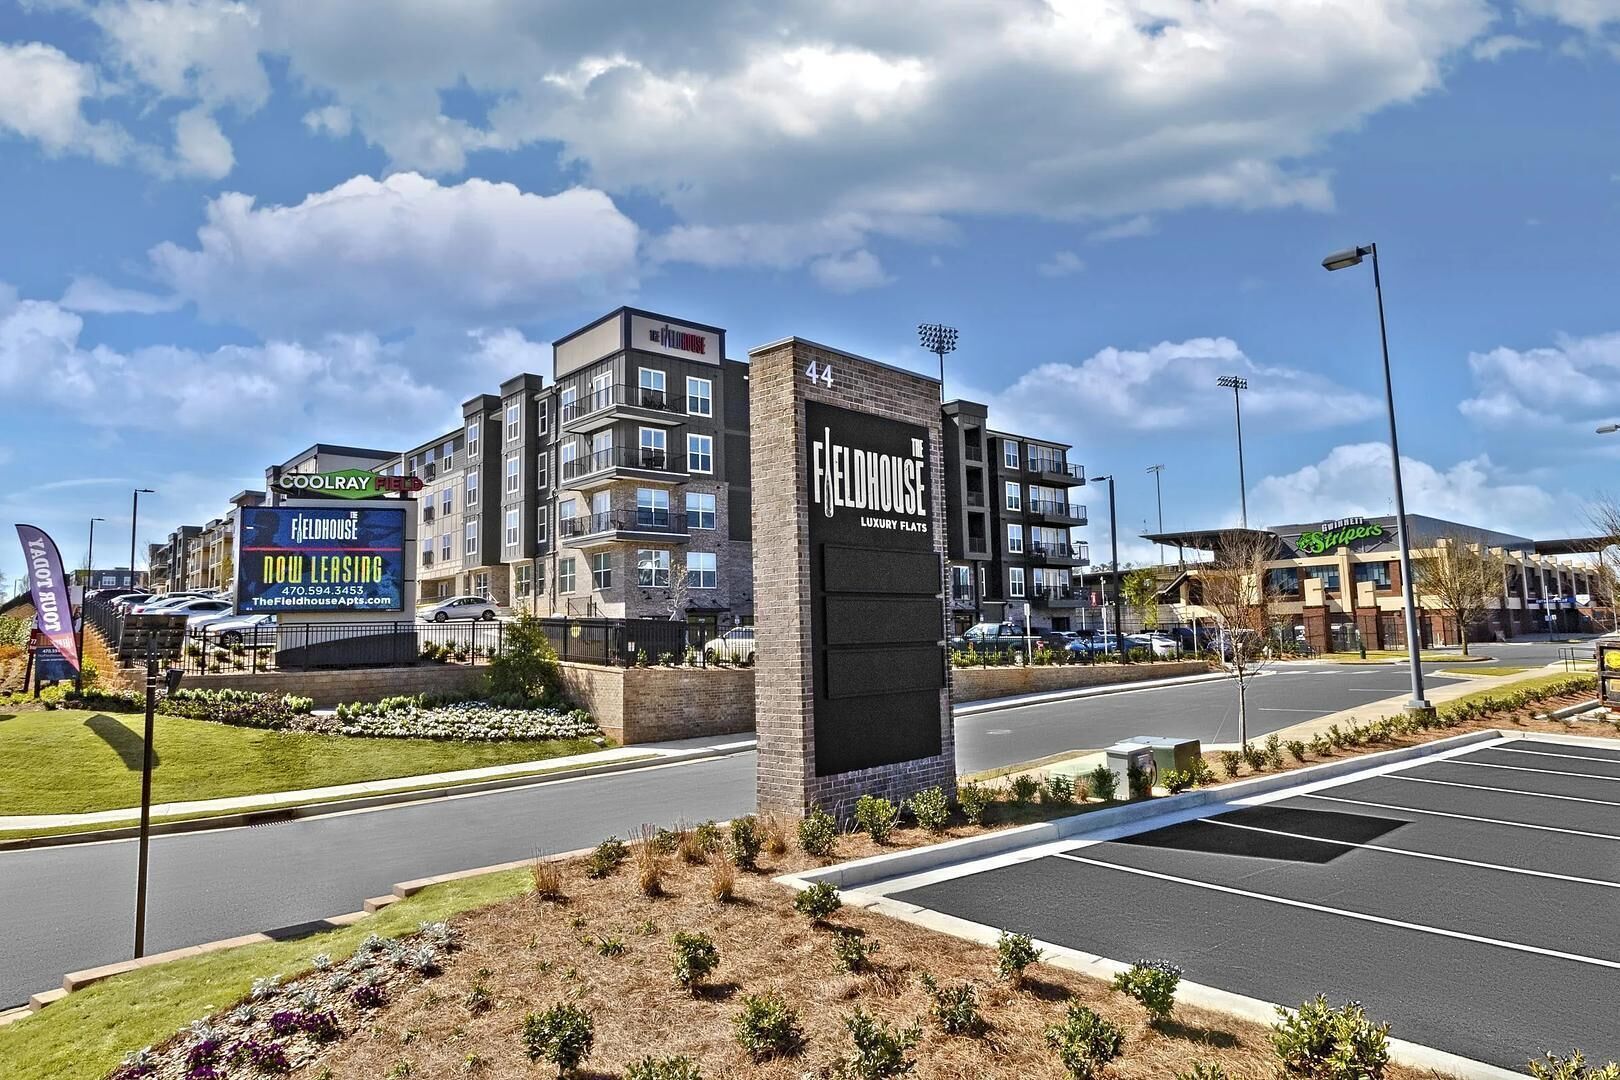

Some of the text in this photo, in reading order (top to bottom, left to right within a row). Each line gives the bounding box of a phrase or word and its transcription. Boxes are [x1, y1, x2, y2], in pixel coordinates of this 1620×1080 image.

[805, 360, 834, 388] 44
[911, 438, 924, 458] THE
[813, 427, 927, 518] FIELDHOUSE
[279, 474, 424, 492] COOLRAY FIELD
[291, 513, 358, 543] FIELDHOUSE
[860, 516, 928, 533] LUXURY FLATS
[1321, 517, 1364, 532] GWINNETT
[1311, 524, 1383, 554] Stripers
[263, 555, 382, 584] NOW LEASING
[281, 586, 364, 596] 470.594.3453
[252, 596, 391, 607] TheFieldhouseApts.com
